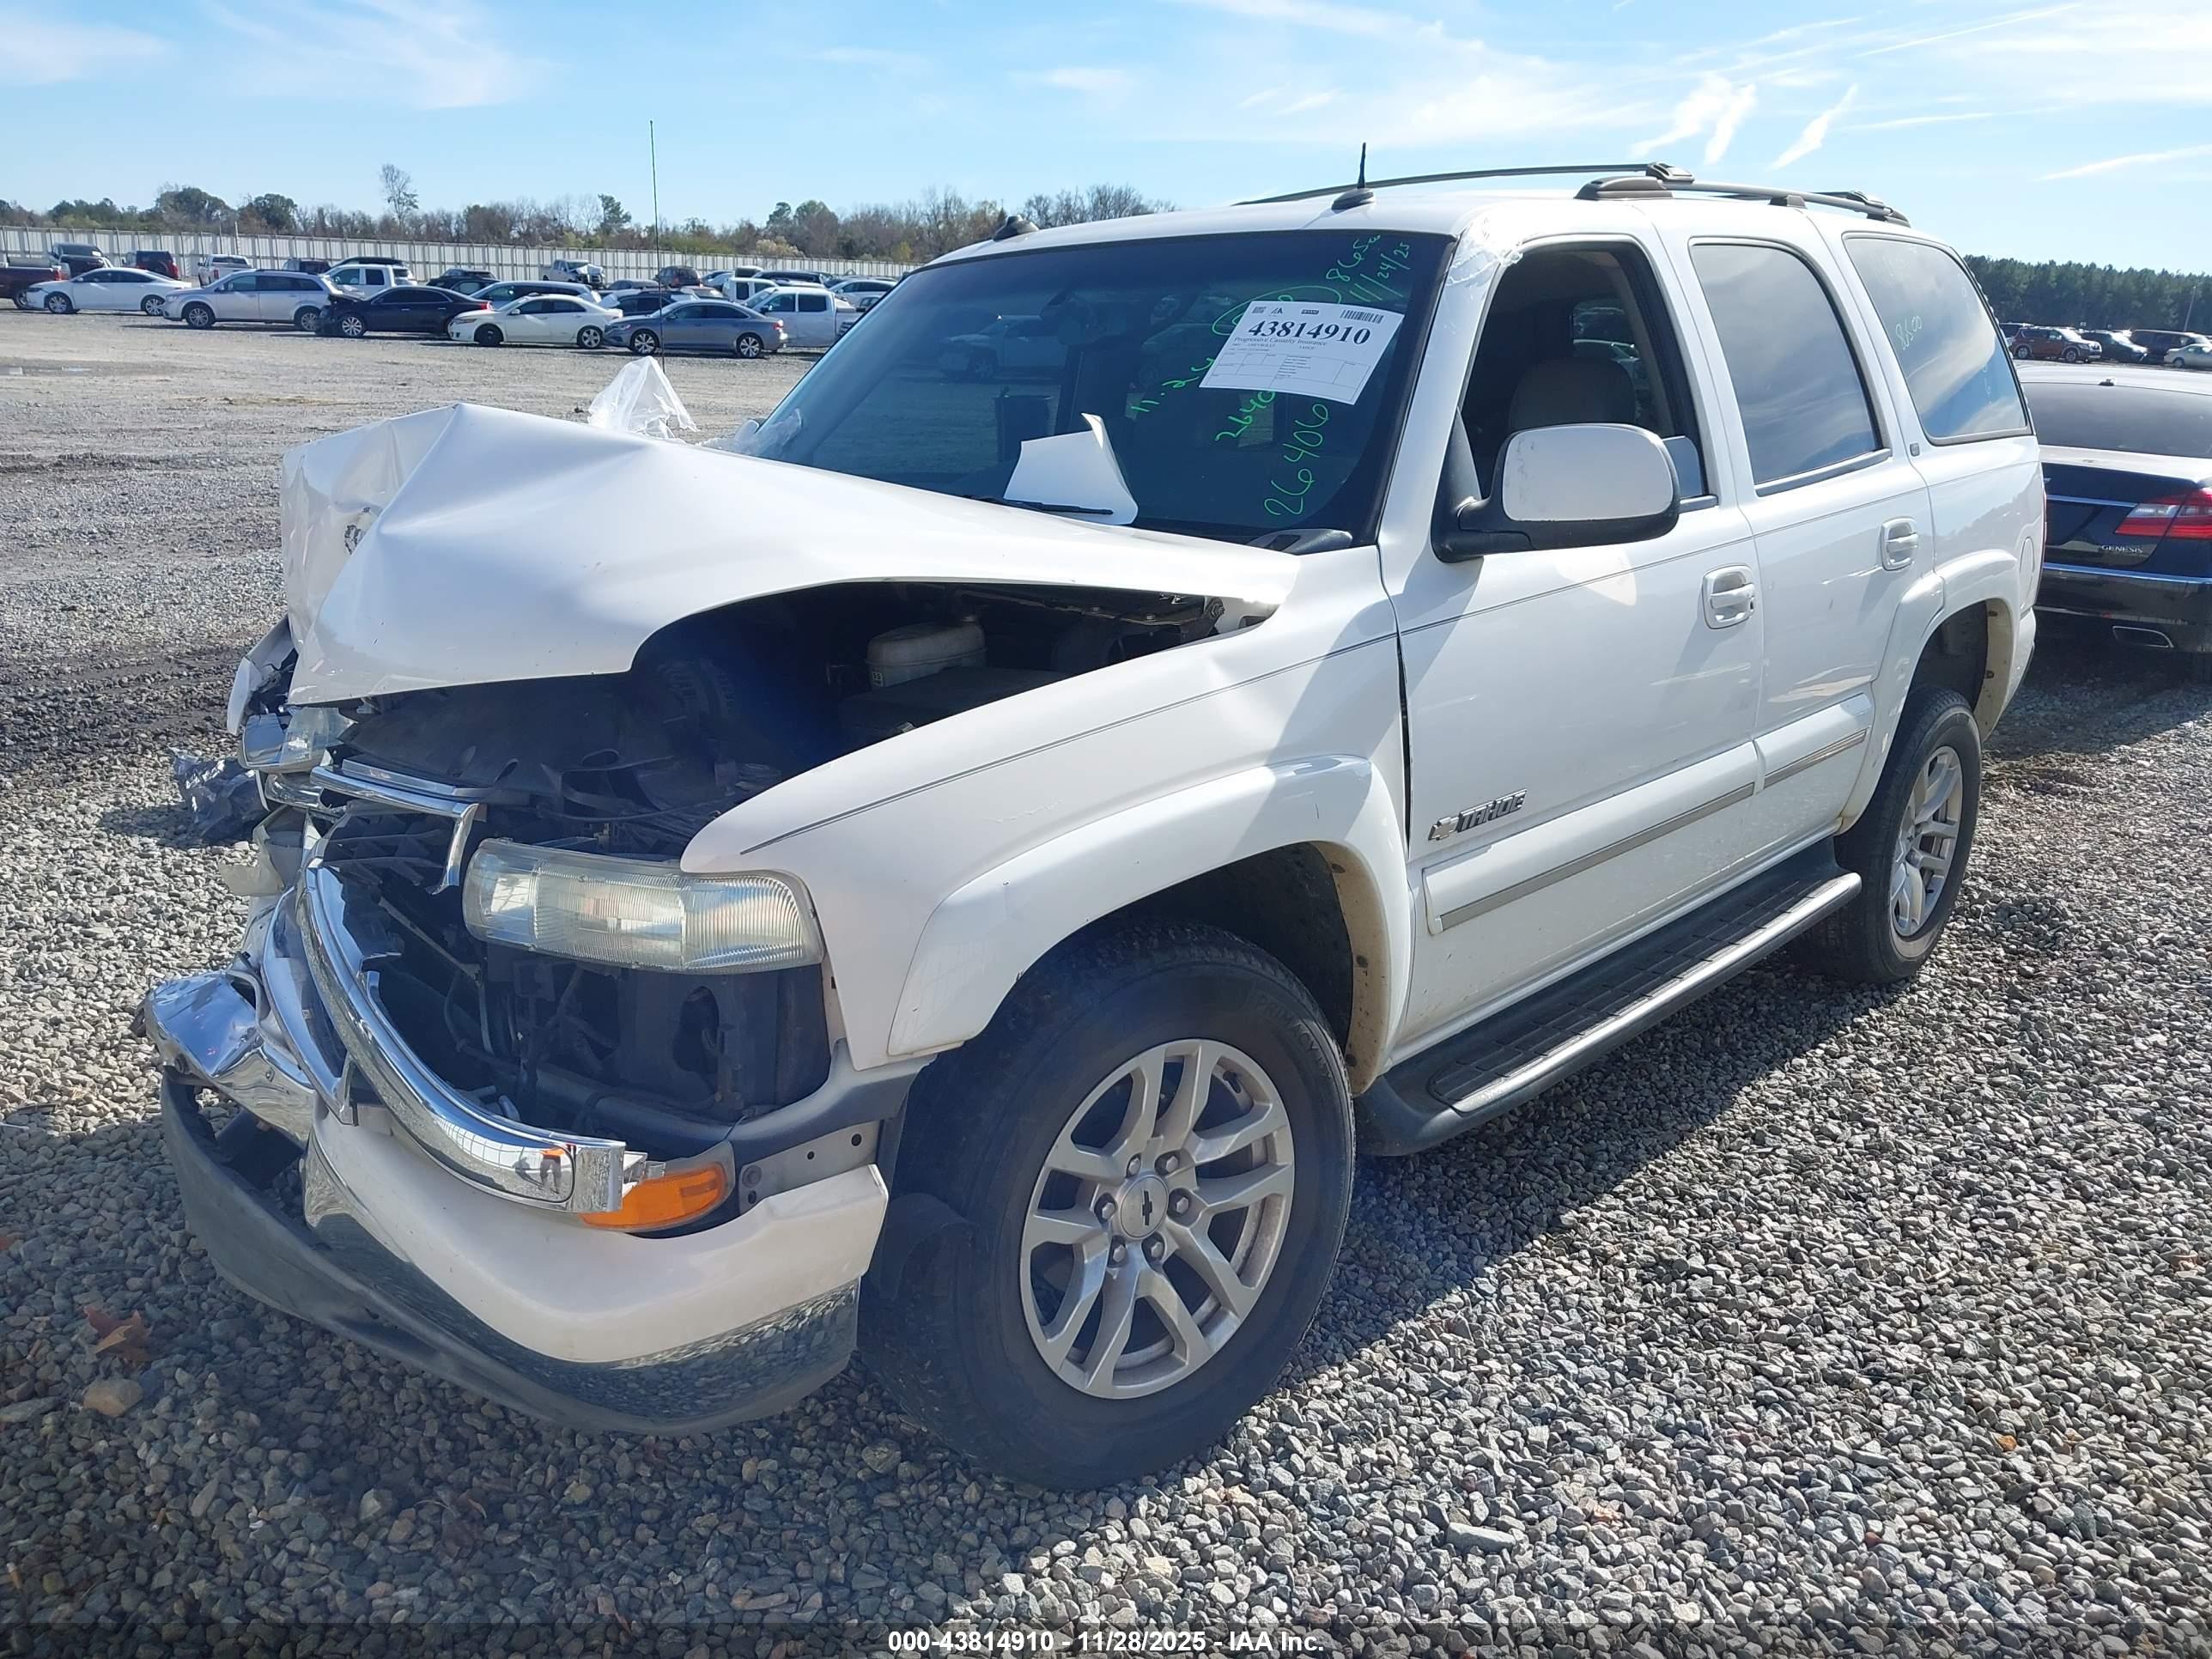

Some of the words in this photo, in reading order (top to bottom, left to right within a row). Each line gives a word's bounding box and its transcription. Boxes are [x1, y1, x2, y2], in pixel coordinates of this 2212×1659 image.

[1248, 319, 1371, 345] 43814910
[1263, 404, 1328, 516] 26406
[2101, 544, 2143, 554] GENESIS
[1455, 788, 1527, 833] TAHOE
